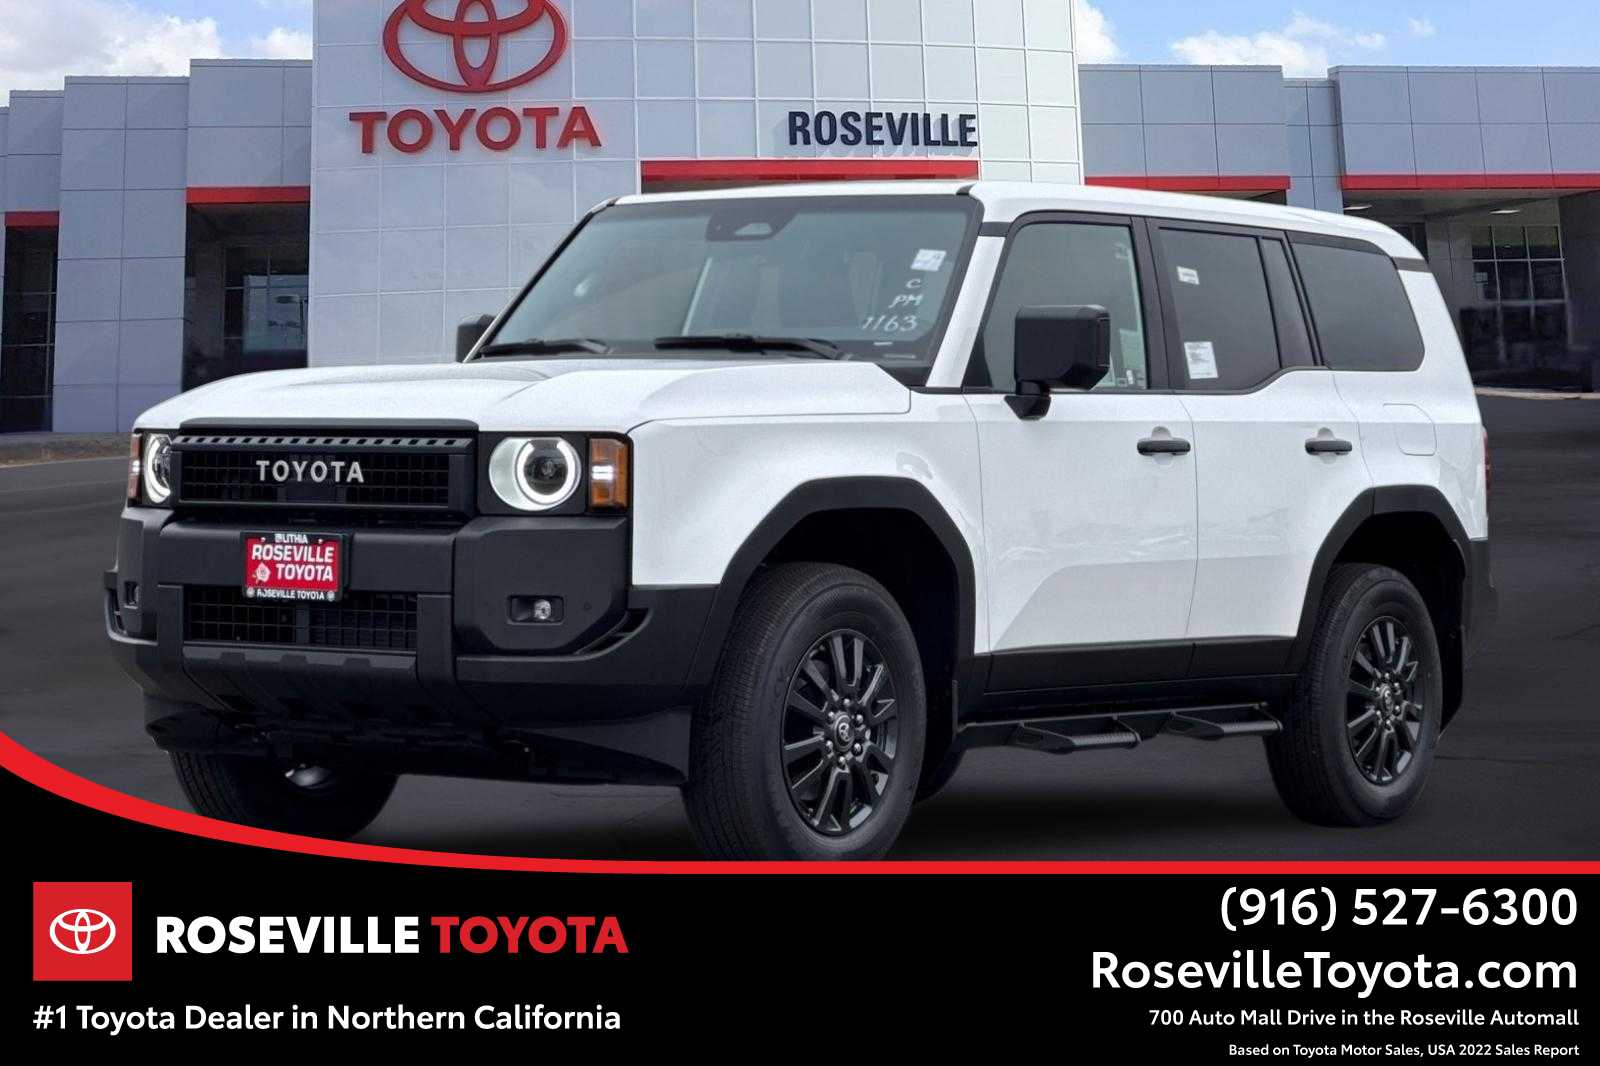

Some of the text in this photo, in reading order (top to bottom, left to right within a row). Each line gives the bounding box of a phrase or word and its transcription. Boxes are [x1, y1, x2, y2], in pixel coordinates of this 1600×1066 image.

[350, 105, 602, 155] TOYOTA
[787, 110, 979, 147] ROSEVILLE
[861, 314, 918, 333] 1163
[255, 459, 365, 483] TOYOTA
[251, 543, 335, 563] ROSEVILLE
[275, 563, 334, 582] TOYOTA
